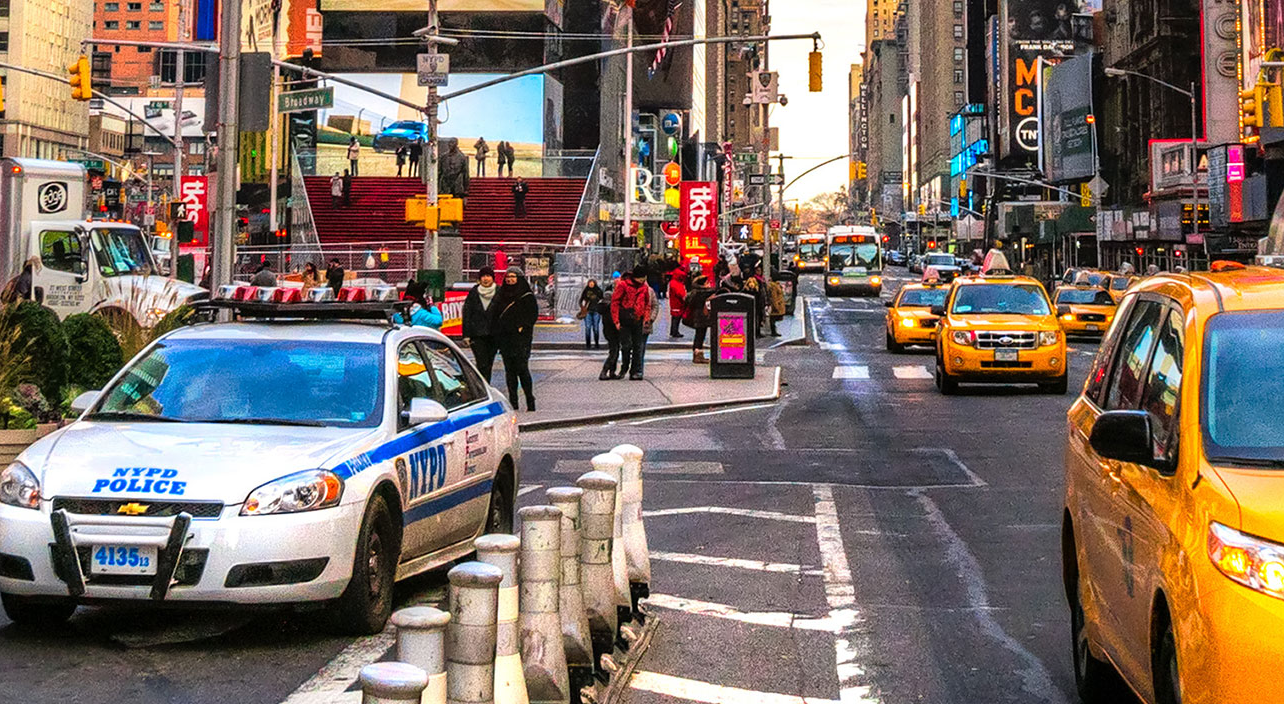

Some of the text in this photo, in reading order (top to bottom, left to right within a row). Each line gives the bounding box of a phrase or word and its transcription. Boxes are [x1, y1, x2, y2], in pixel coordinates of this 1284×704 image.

[284, 94, 325, 108] Broadway
[1021, 129, 1038, 140] TN
[183, 180, 204, 226] tkts
[690, 186, 712, 231] tkts
[441, 302, 463, 320] BOY
[112, 467, 178, 479] NYPD
[409, 443, 446, 501] NYPD
[92, 479, 187, 495] POLICE
[95, 546, 140, 567] 4135
